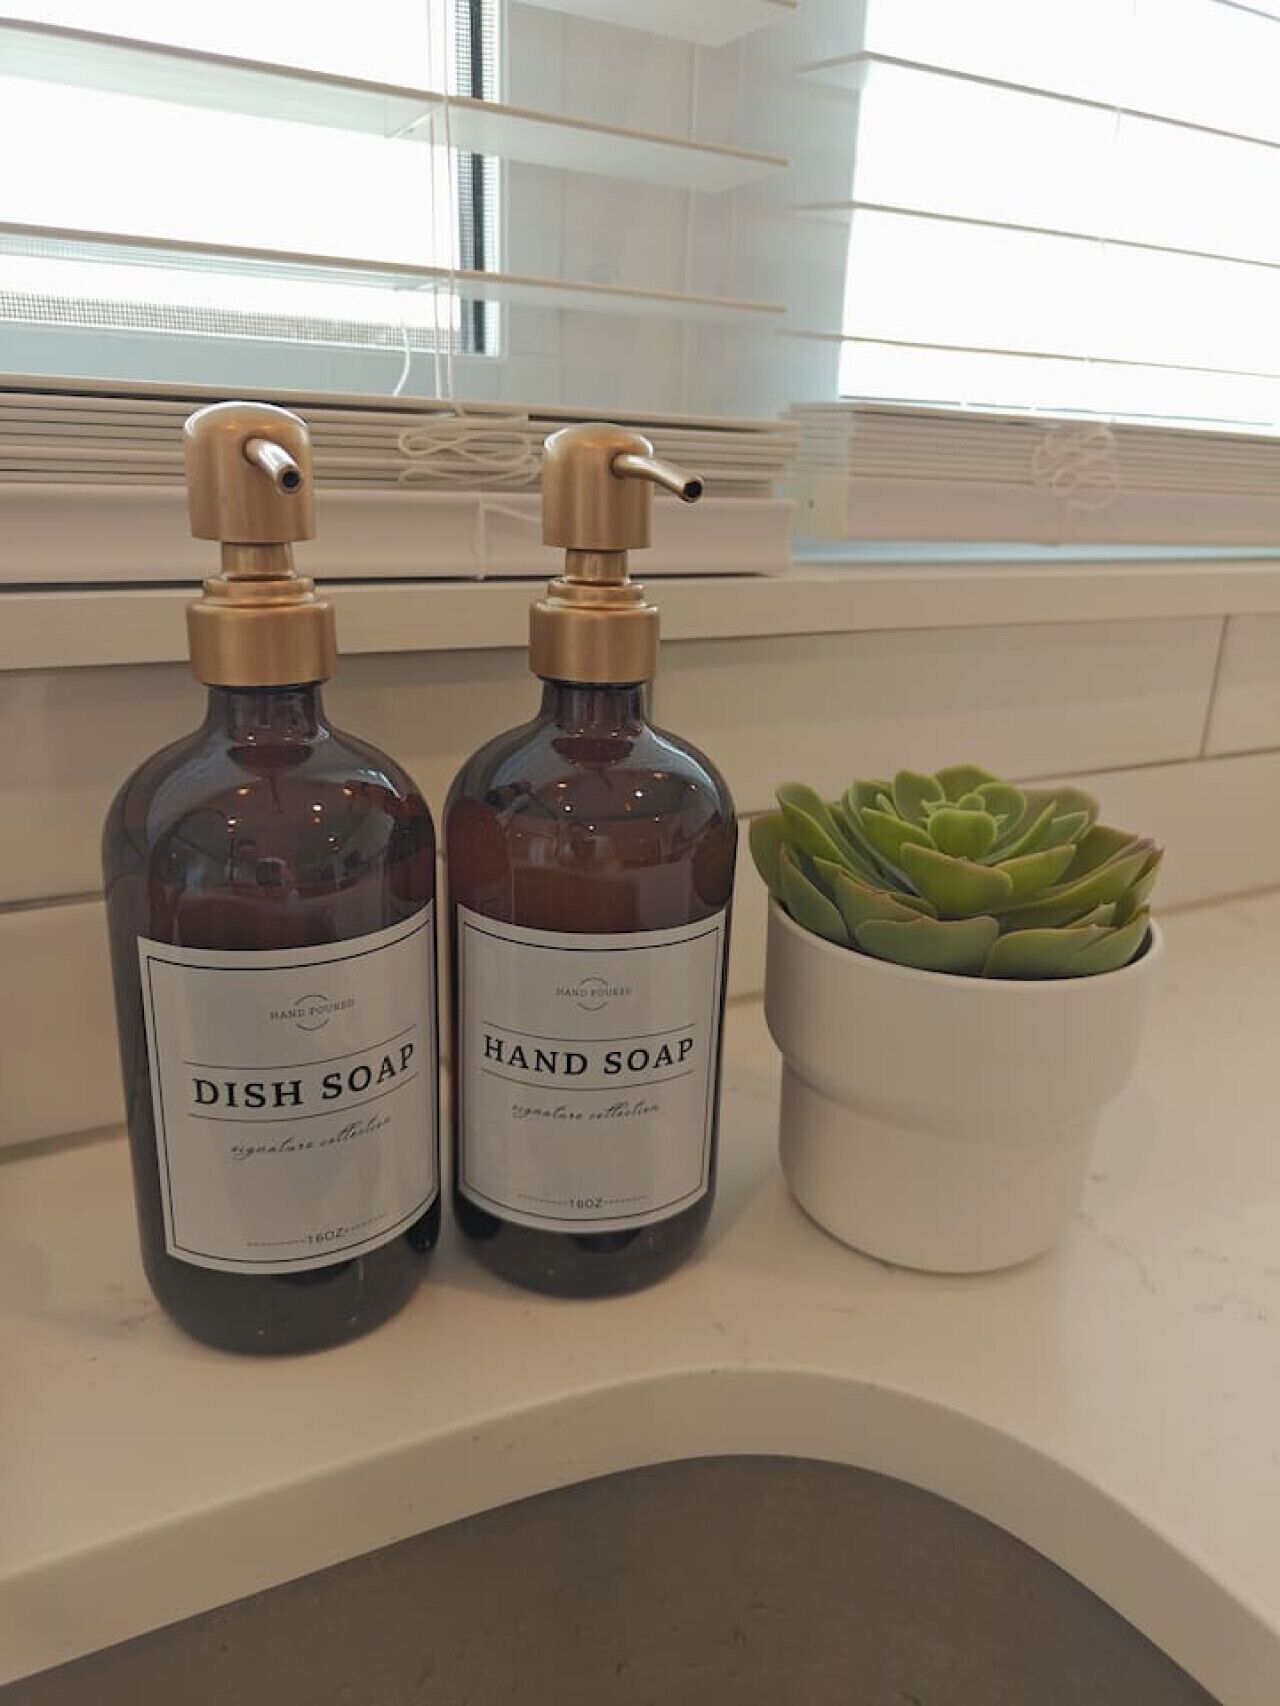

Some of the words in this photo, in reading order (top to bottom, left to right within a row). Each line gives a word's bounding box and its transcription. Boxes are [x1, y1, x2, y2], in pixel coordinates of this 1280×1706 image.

[556, 987, 588, 998] HAND
[269, 1008, 306, 1022] HAND
[309, 998, 356, 1016] POURED
[483, 1035, 588, 1075] HAND
[603, 1038, 694, 1074] SOAP
[192, 1078, 304, 1108] DISH
[321, 1043, 415, 1100] SOAP
[511, 1103, 584, 1121] signature
[587, 1100, 660, 1121] collection
[230, 1136, 315, 1161] signature
[318, 1115, 392, 1149] collection
